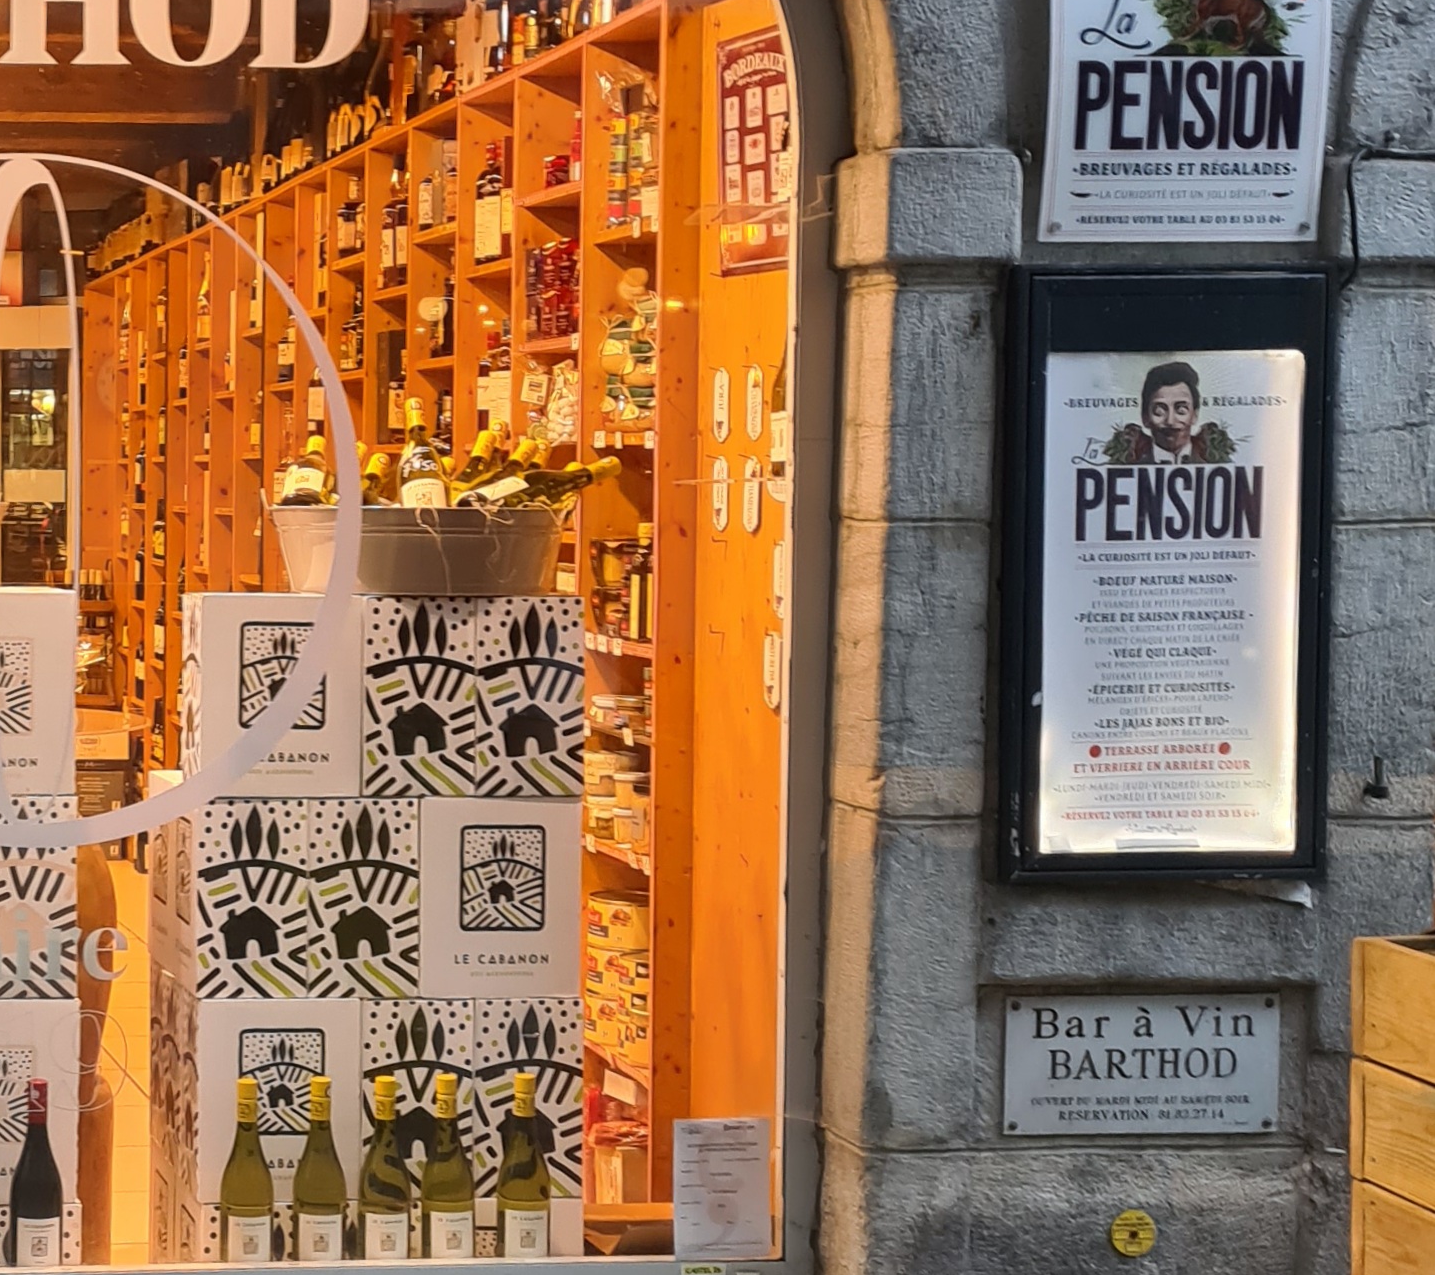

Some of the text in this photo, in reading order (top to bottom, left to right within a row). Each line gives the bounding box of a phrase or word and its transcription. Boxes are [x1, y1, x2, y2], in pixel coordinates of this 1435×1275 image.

[1073, 60, 1304, 151] PENSION
[1080, 162, 1172, 175] BREUVAGES
[1177, 162, 1194, 175] ET
[1075, 466, 1264, 541] PENSION
[1148, 684, 1161, 694] ET
[453, 953, 550, 965] LE CABANON
[1031, 1005, 1255, 1039] Bar à Vin
[1048, 1047, 1237, 1080] BARTHOD
